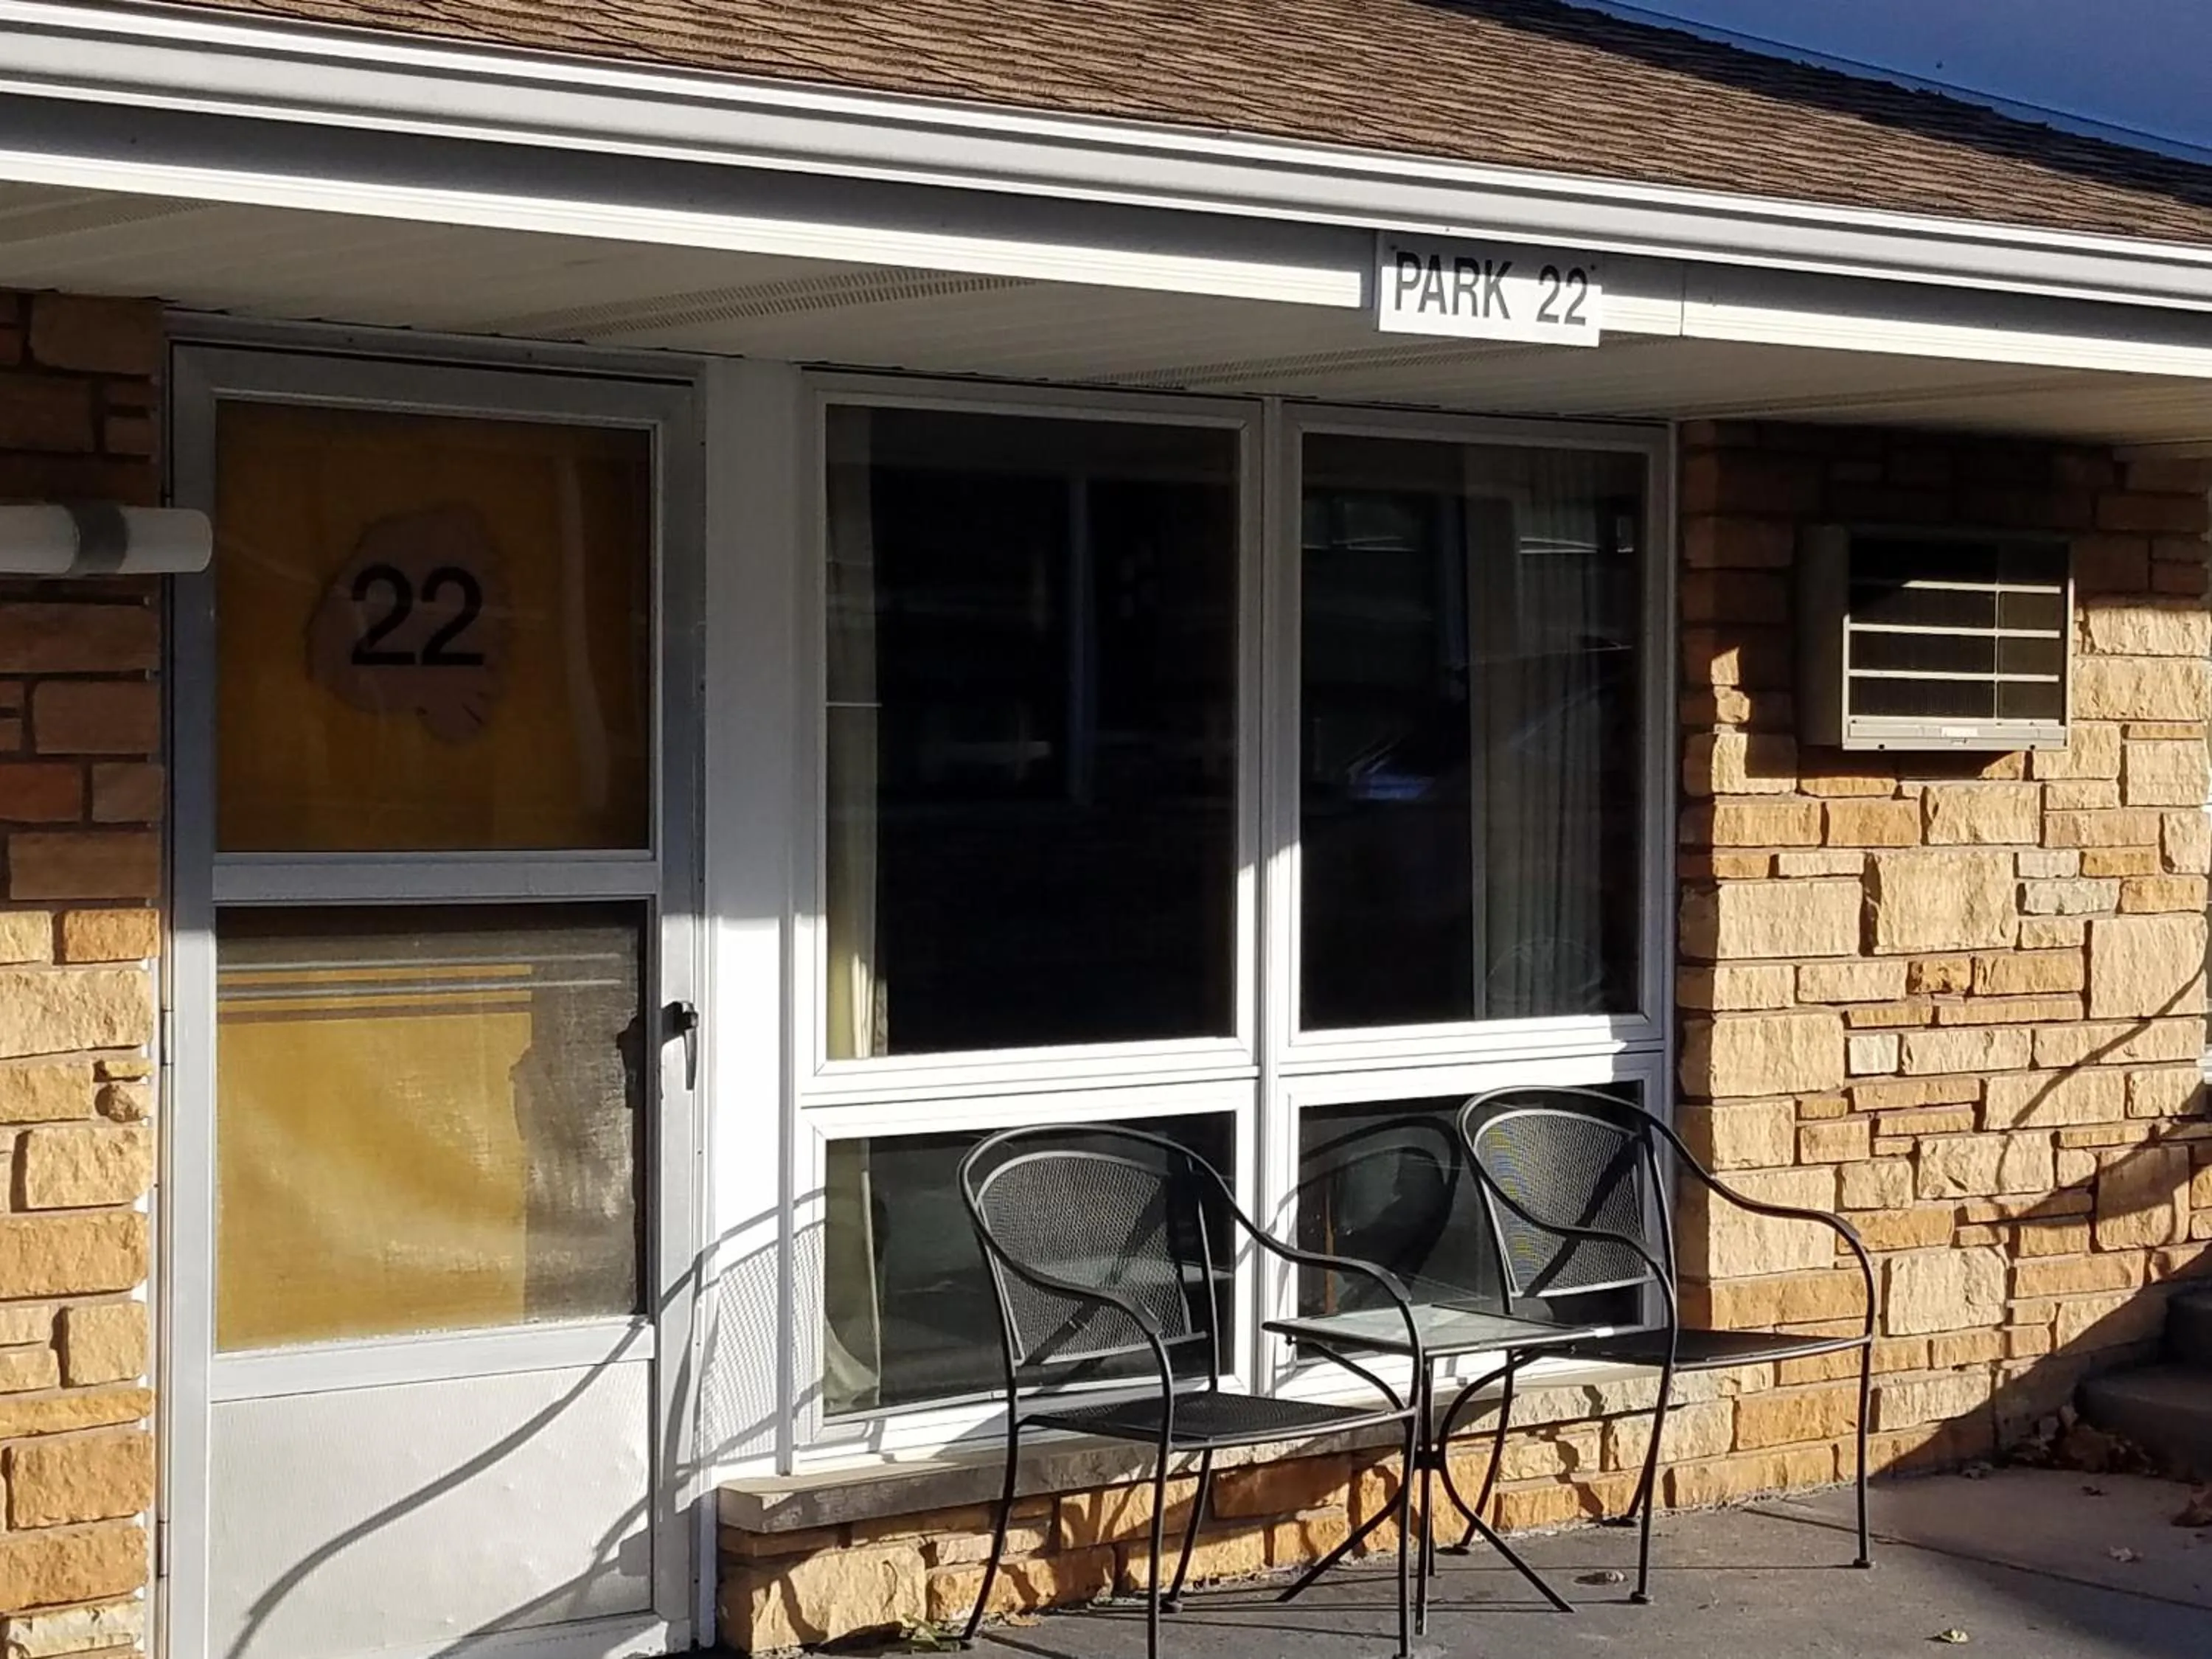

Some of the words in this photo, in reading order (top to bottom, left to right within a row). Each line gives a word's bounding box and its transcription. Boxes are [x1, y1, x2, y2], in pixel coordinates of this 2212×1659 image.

[1394, 251, 1512, 319] PARK
[1536, 265, 1587, 326] 22
[351, 564, 484, 666] 22
